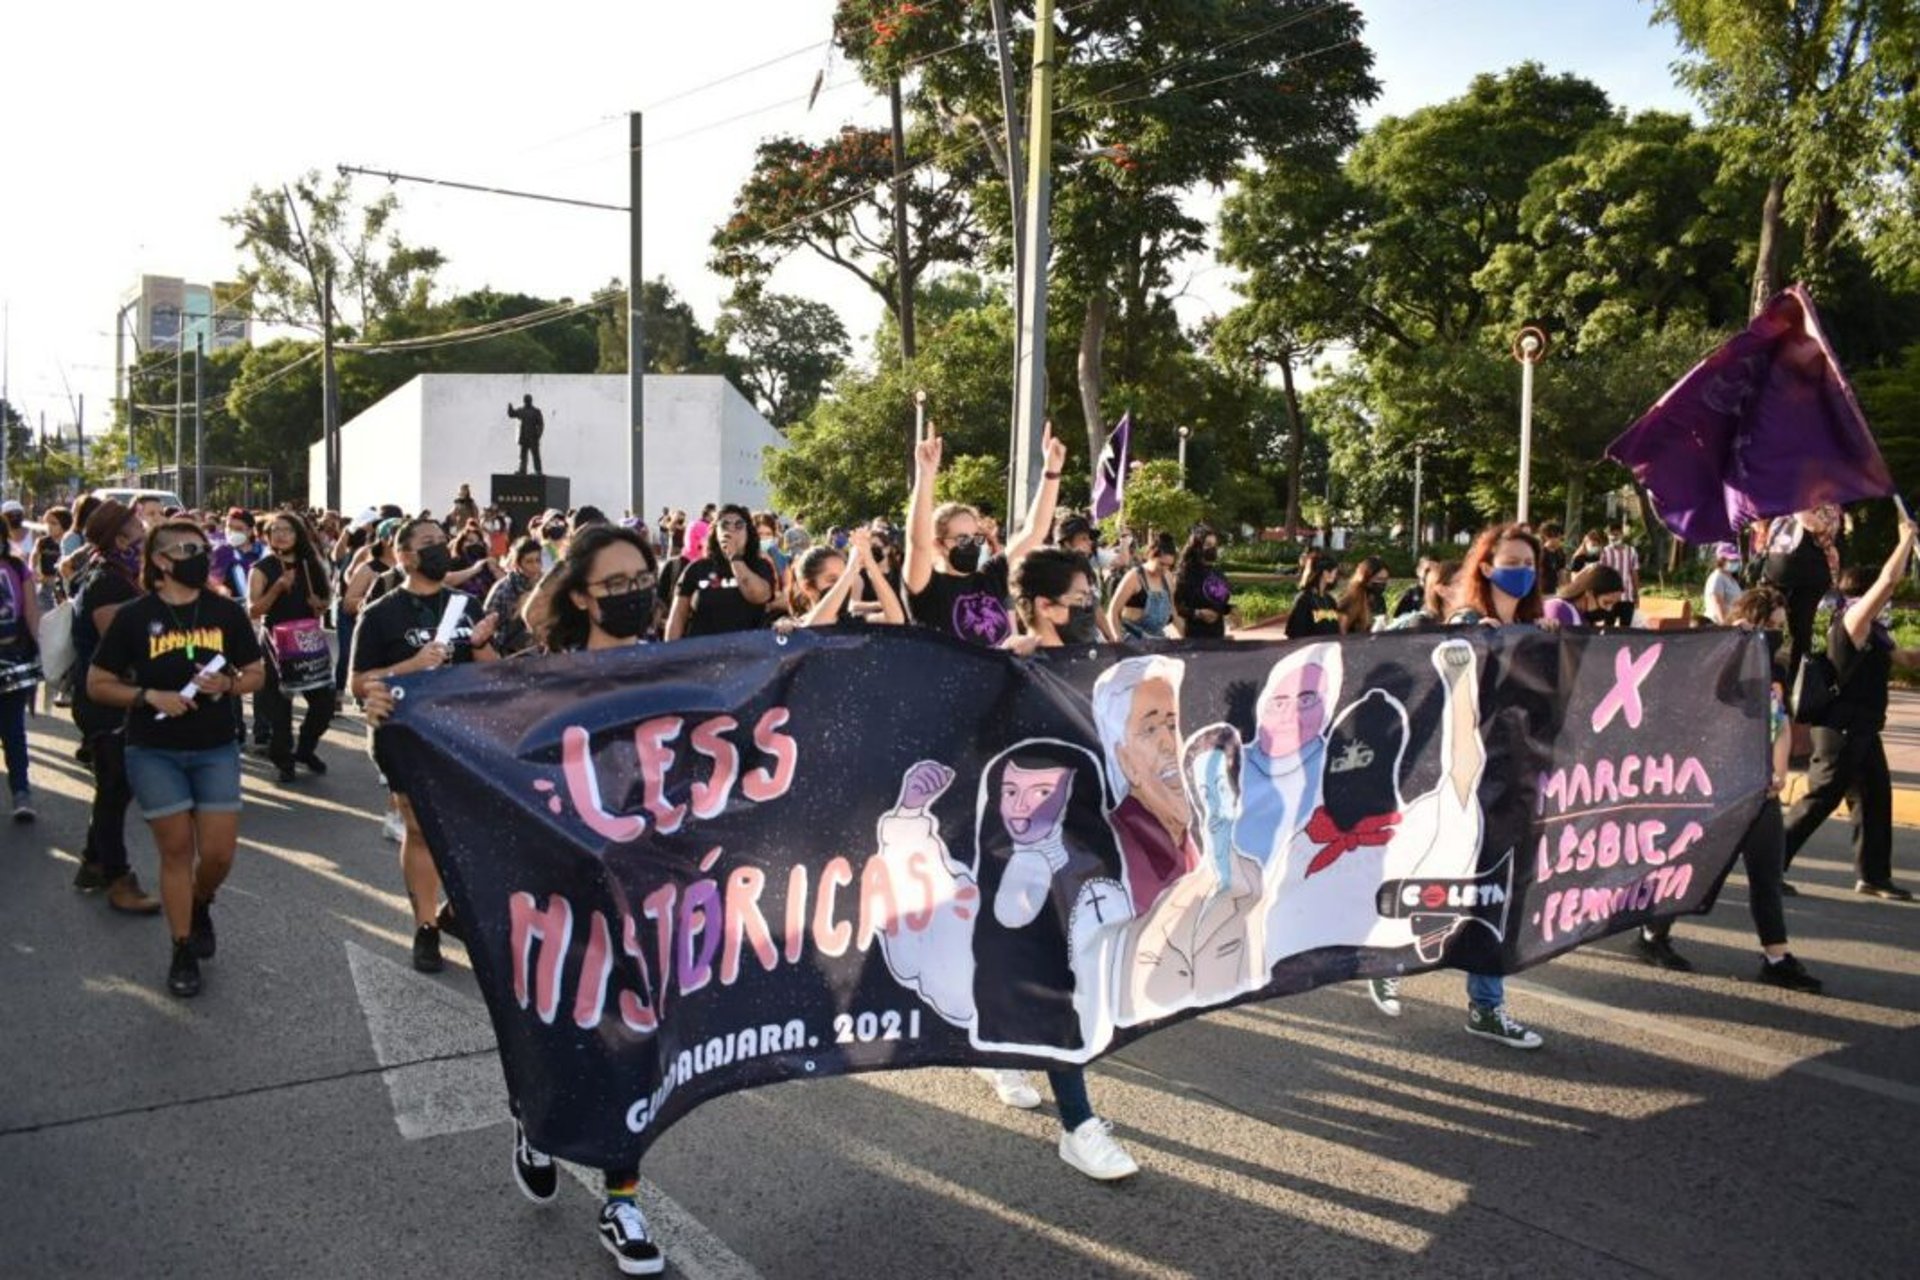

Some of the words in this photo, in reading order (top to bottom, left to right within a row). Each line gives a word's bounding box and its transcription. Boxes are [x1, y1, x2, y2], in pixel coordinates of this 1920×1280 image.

[1591, 642, 1663, 733] X
[562, 706, 798, 843] LESS
[1537, 753, 1713, 815] MARCHA
[834, 1009, 920, 1045] 2021
